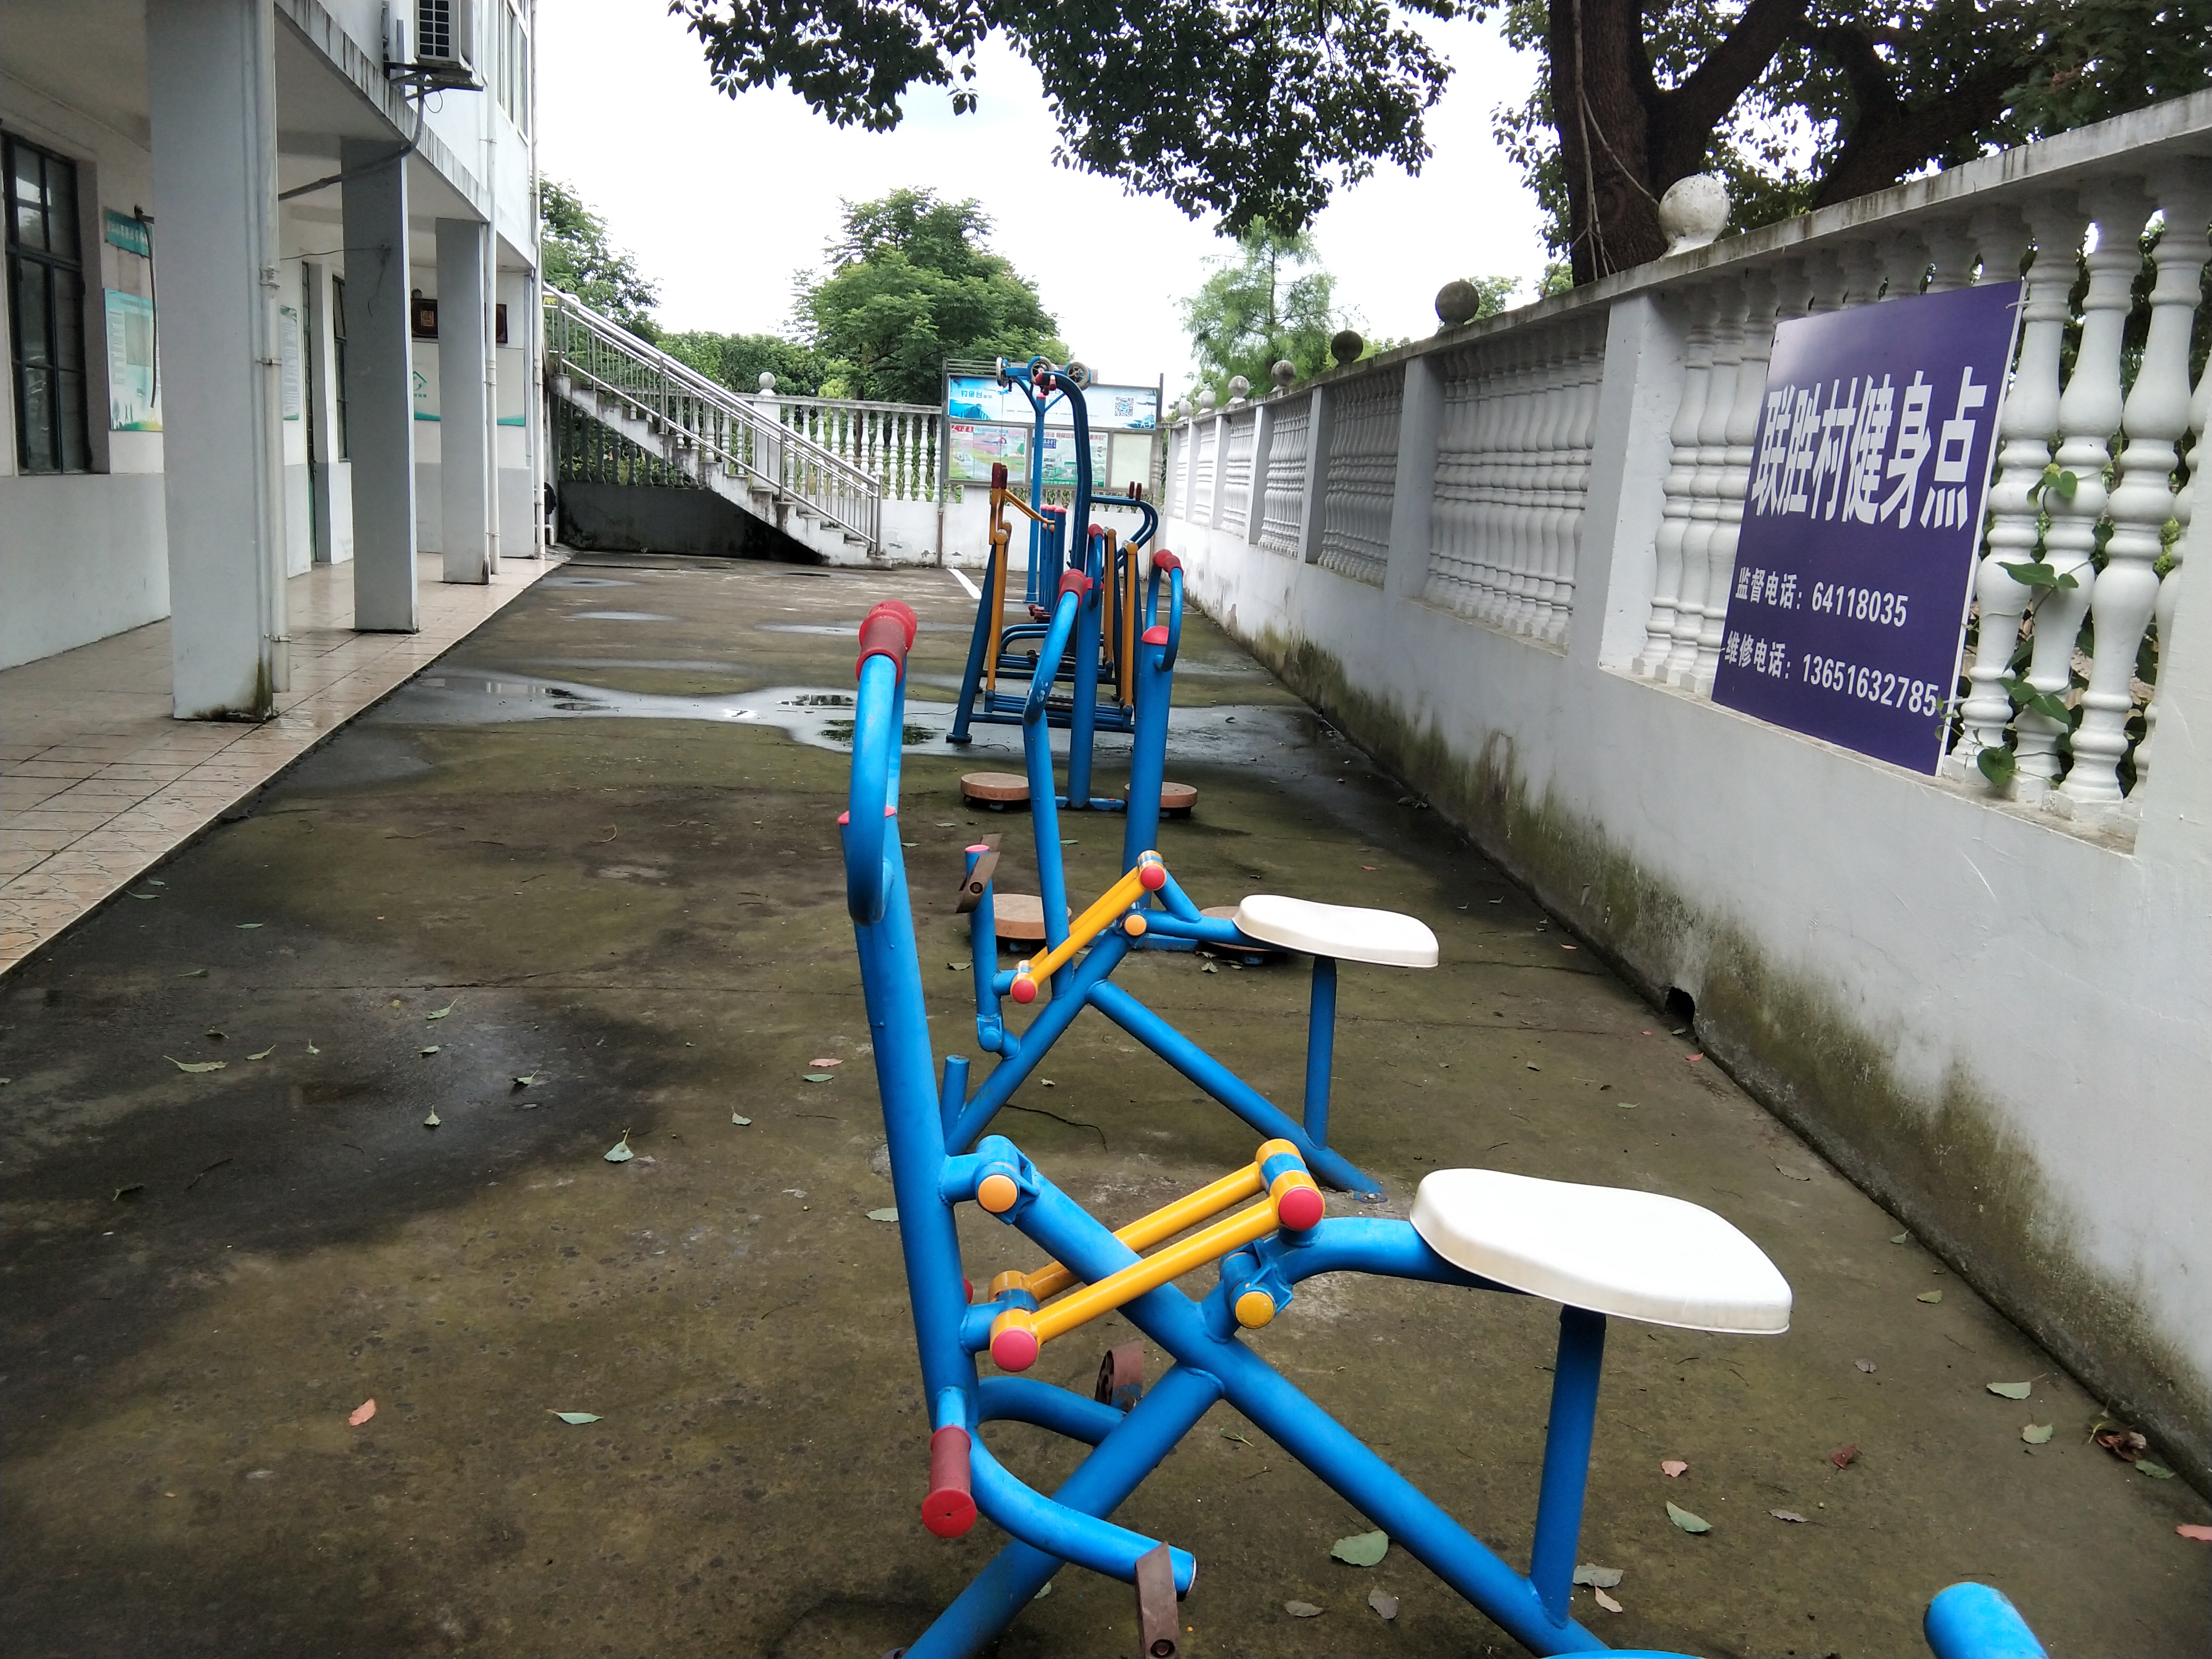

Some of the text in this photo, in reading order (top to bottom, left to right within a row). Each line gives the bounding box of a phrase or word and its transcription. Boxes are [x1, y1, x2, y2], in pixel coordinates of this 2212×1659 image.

[1751, 366, 1988, 531] 联胜村健身点
